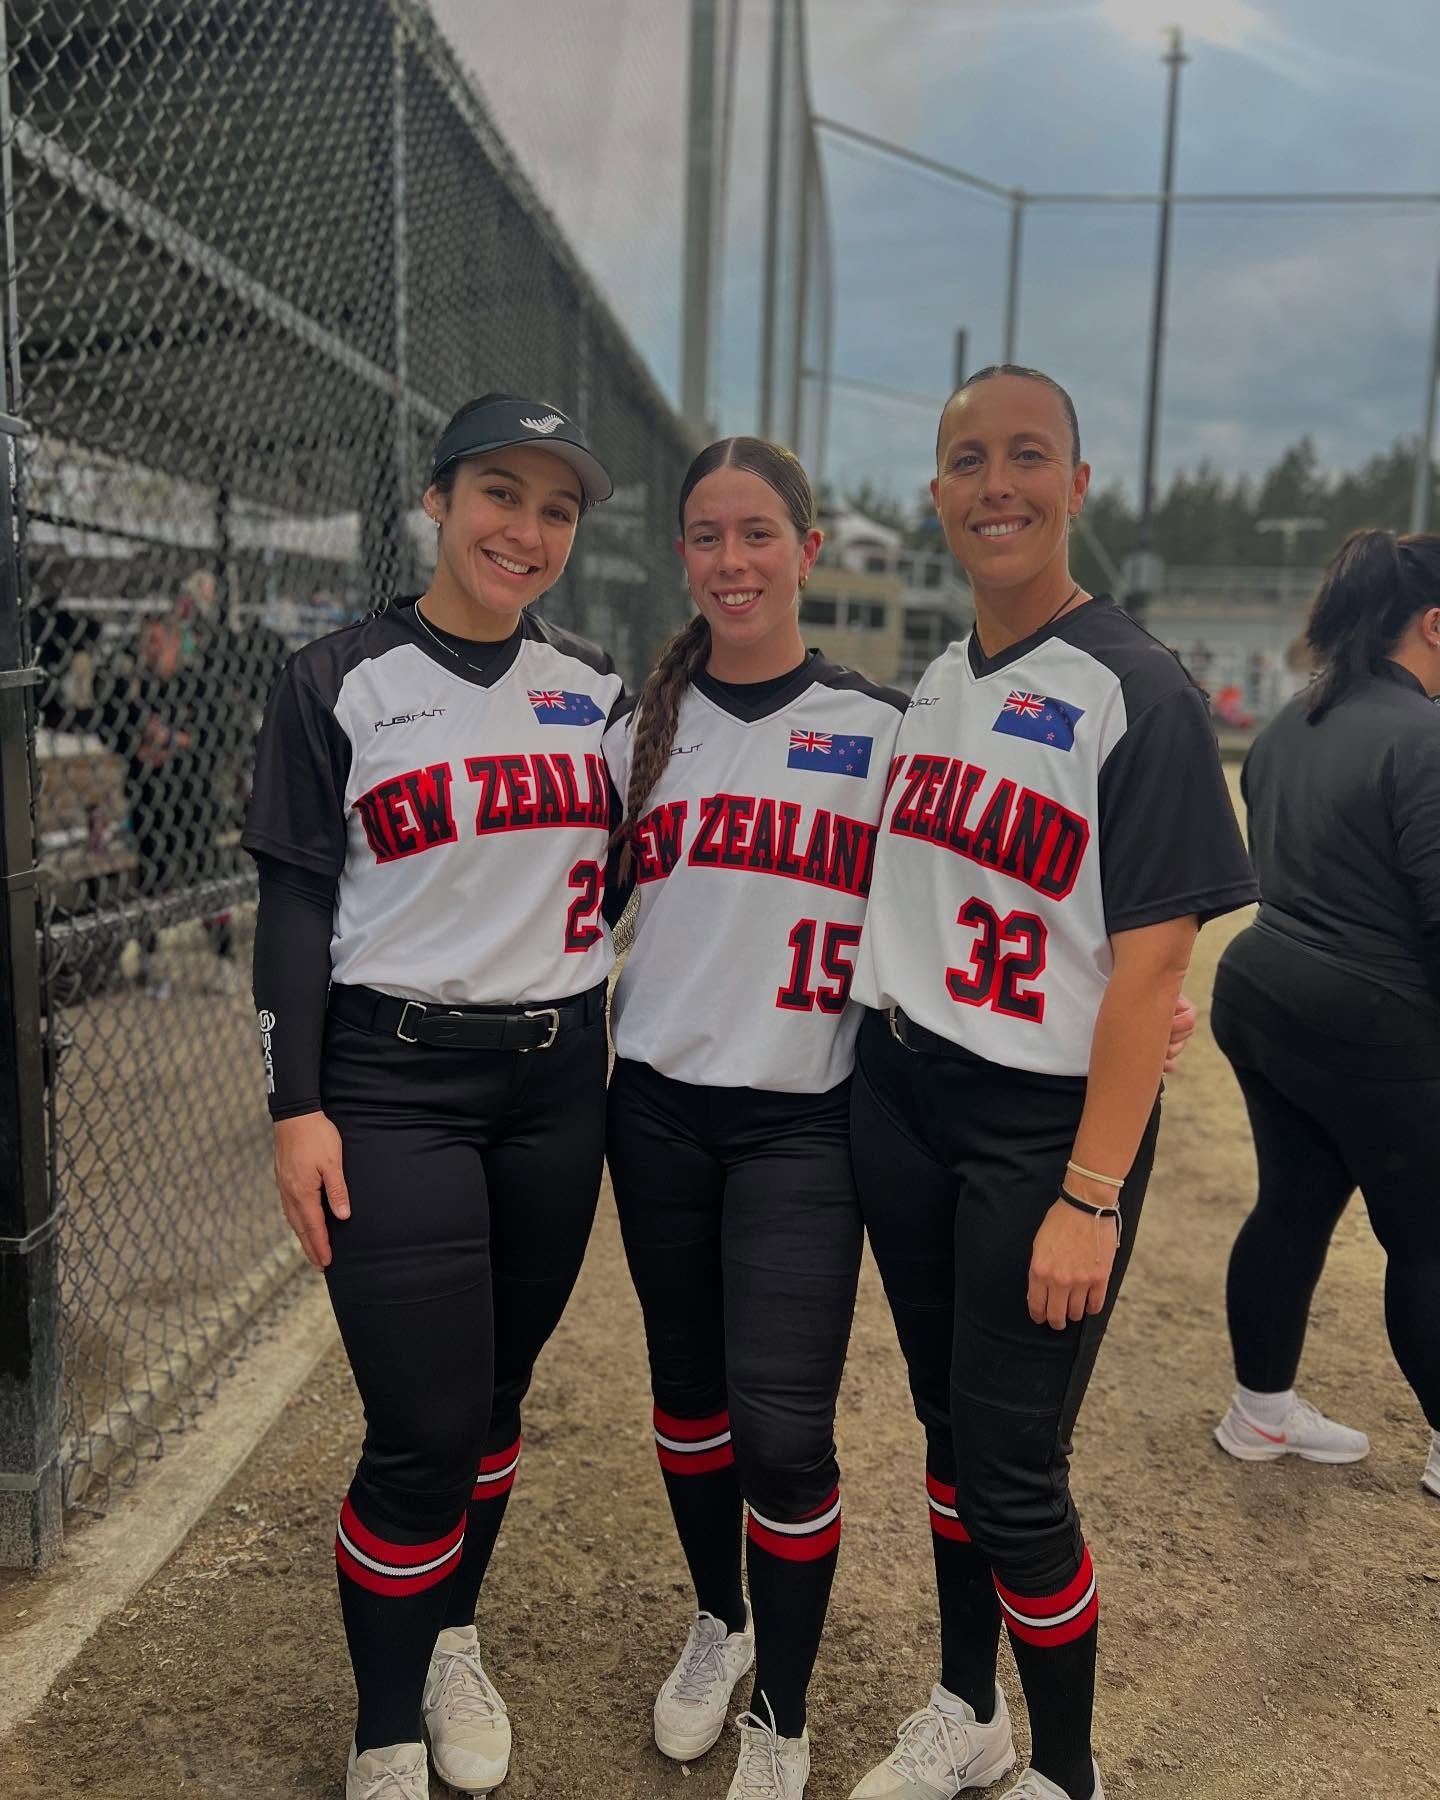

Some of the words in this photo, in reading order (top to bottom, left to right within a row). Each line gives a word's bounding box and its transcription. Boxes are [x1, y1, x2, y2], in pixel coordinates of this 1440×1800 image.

[352, 761, 458, 865] NEW
[464, 753, 608, 836] ZEALA
[636, 800, 688, 885] EW
[889, 753, 1091, 902] ZEALAND
[563, 860, 606, 953] 2
[775, 918, 863, 1014] 15
[945, 896, 1048, 1024] 32
